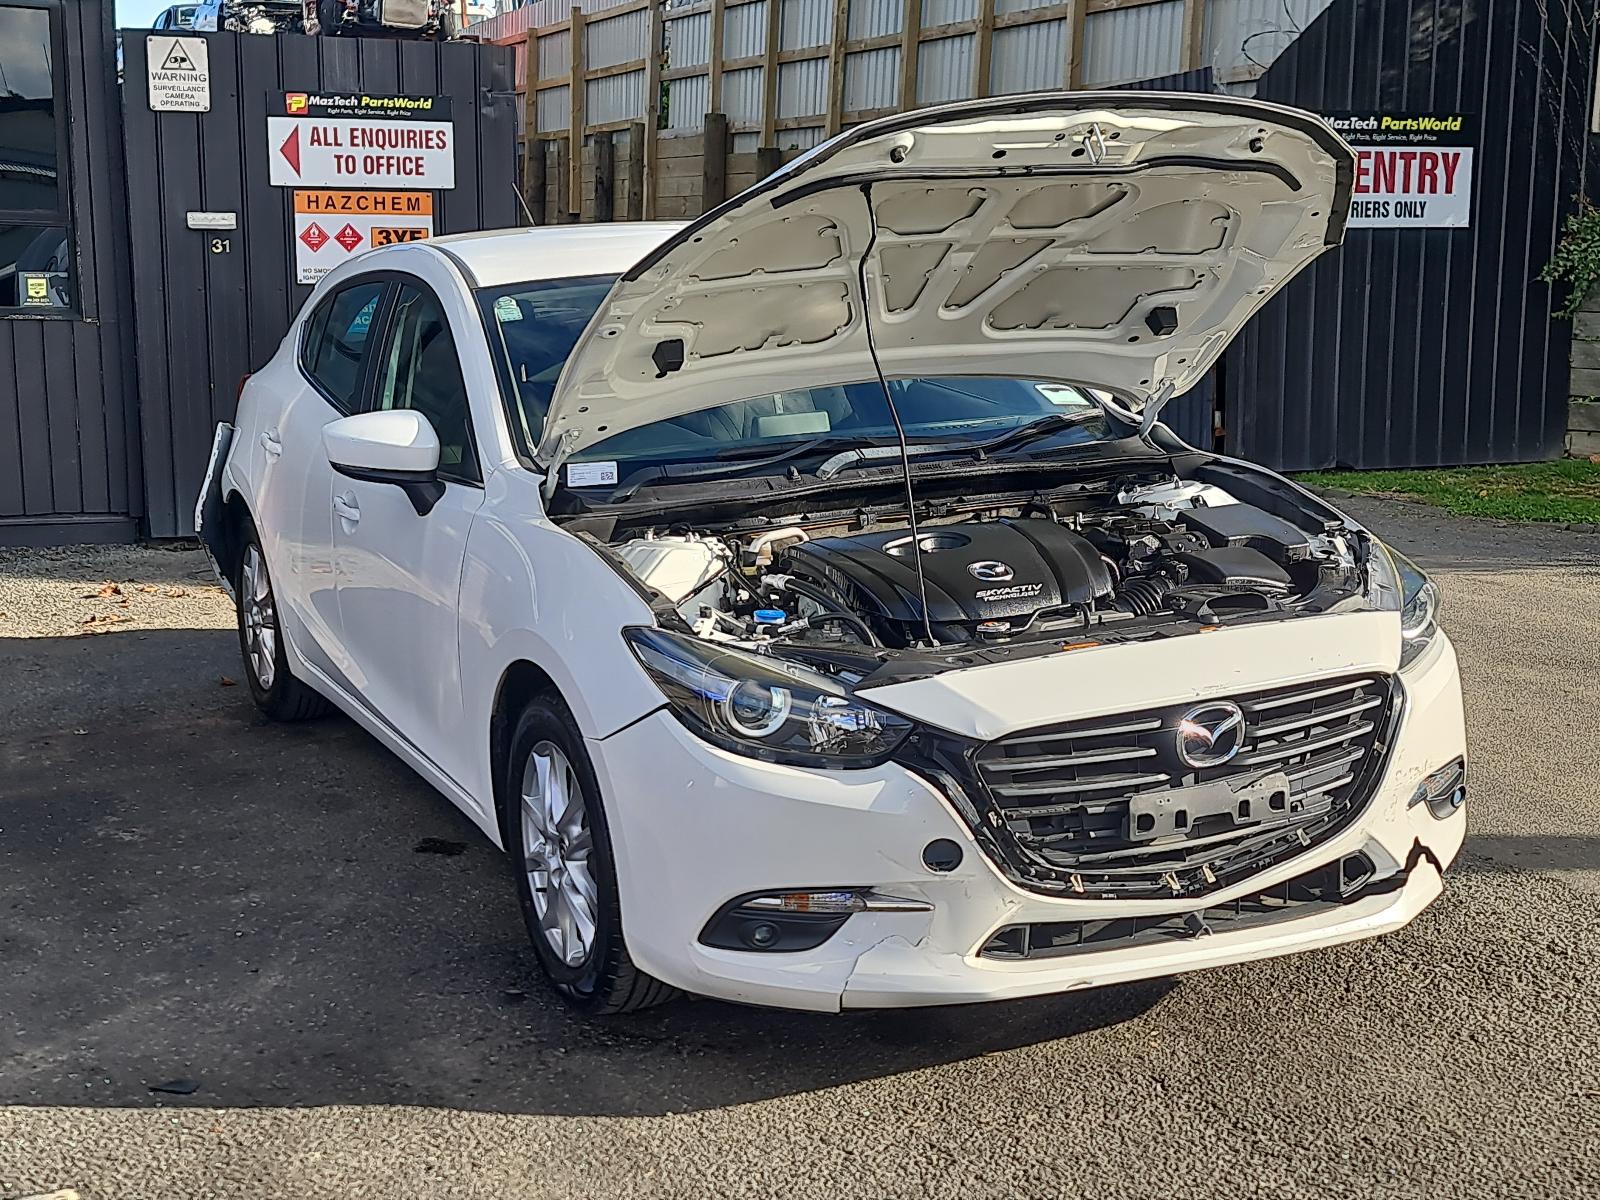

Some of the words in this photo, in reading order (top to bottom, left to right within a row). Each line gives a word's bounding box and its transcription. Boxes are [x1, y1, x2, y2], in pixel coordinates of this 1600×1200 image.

[151, 71, 207, 83] WARNING
[153, 84, 206, 93] SURVEILLANCE
[164, 92, 195, 100] CAMERA
[308, 95, 358, 107] MazTech
[361, 96, 432, 109] PartsWorld
[1380, 116, 1462, 131] PartsWorld
[309, 126, 343, 147] ALL
[350, 127, 447, 150] ENQUIRIES
[334, 154, 356, 175] TO
[363, 155, 425, 176] OFFICE
[1354, 151, 1461, 194] ENTRY
[306, 194, 421, 212] HAZCHEM
[1394, 201, 1427, 219] ONLY
[211, 238, 231, 253] 31
[976, 583, 1042, 598] SKYACTIV
[984, 590, 1041, 602] TECHNOLOGY
